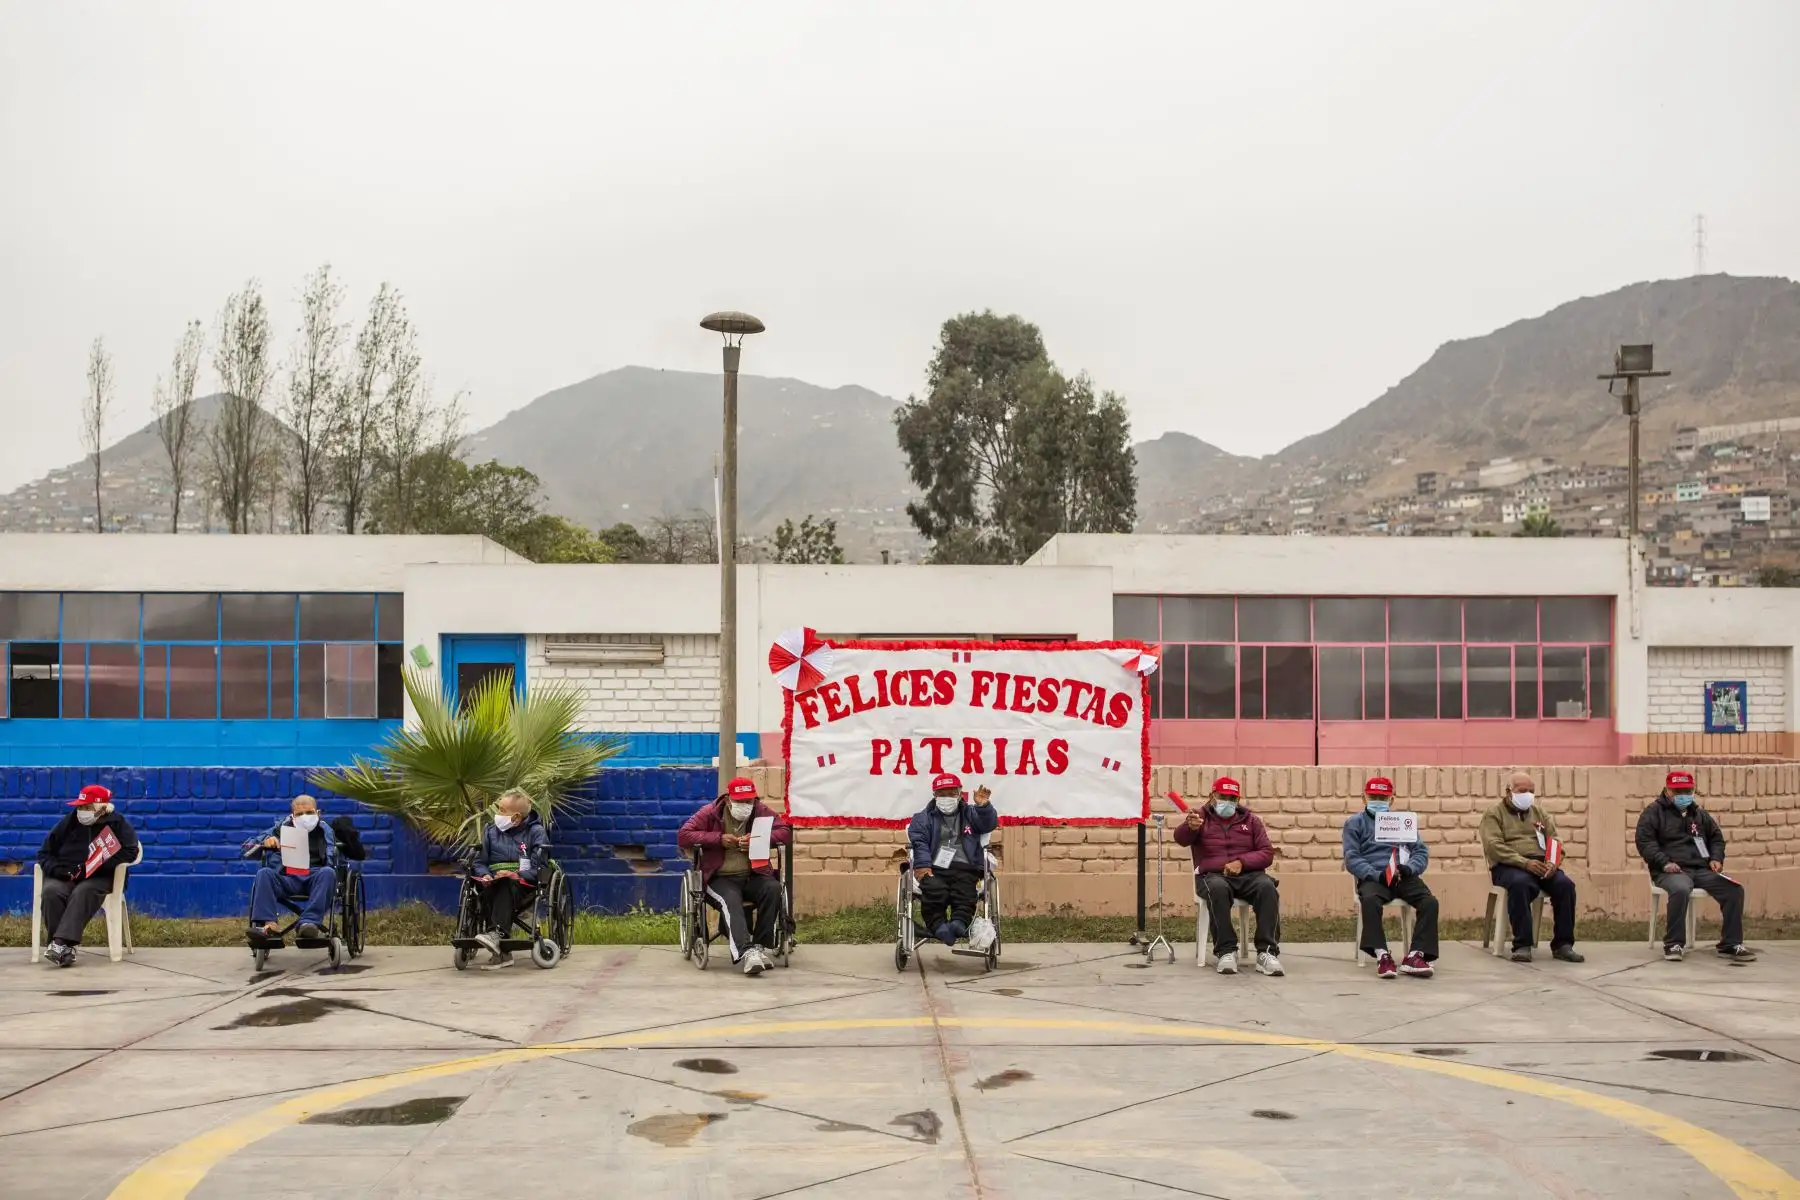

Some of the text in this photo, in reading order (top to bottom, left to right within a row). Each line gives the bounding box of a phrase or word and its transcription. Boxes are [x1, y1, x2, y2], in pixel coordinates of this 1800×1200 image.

[795, 669, 1133, 729] FELICES FIESTAS
[869, 737, 1069, 775] PATRIAS
